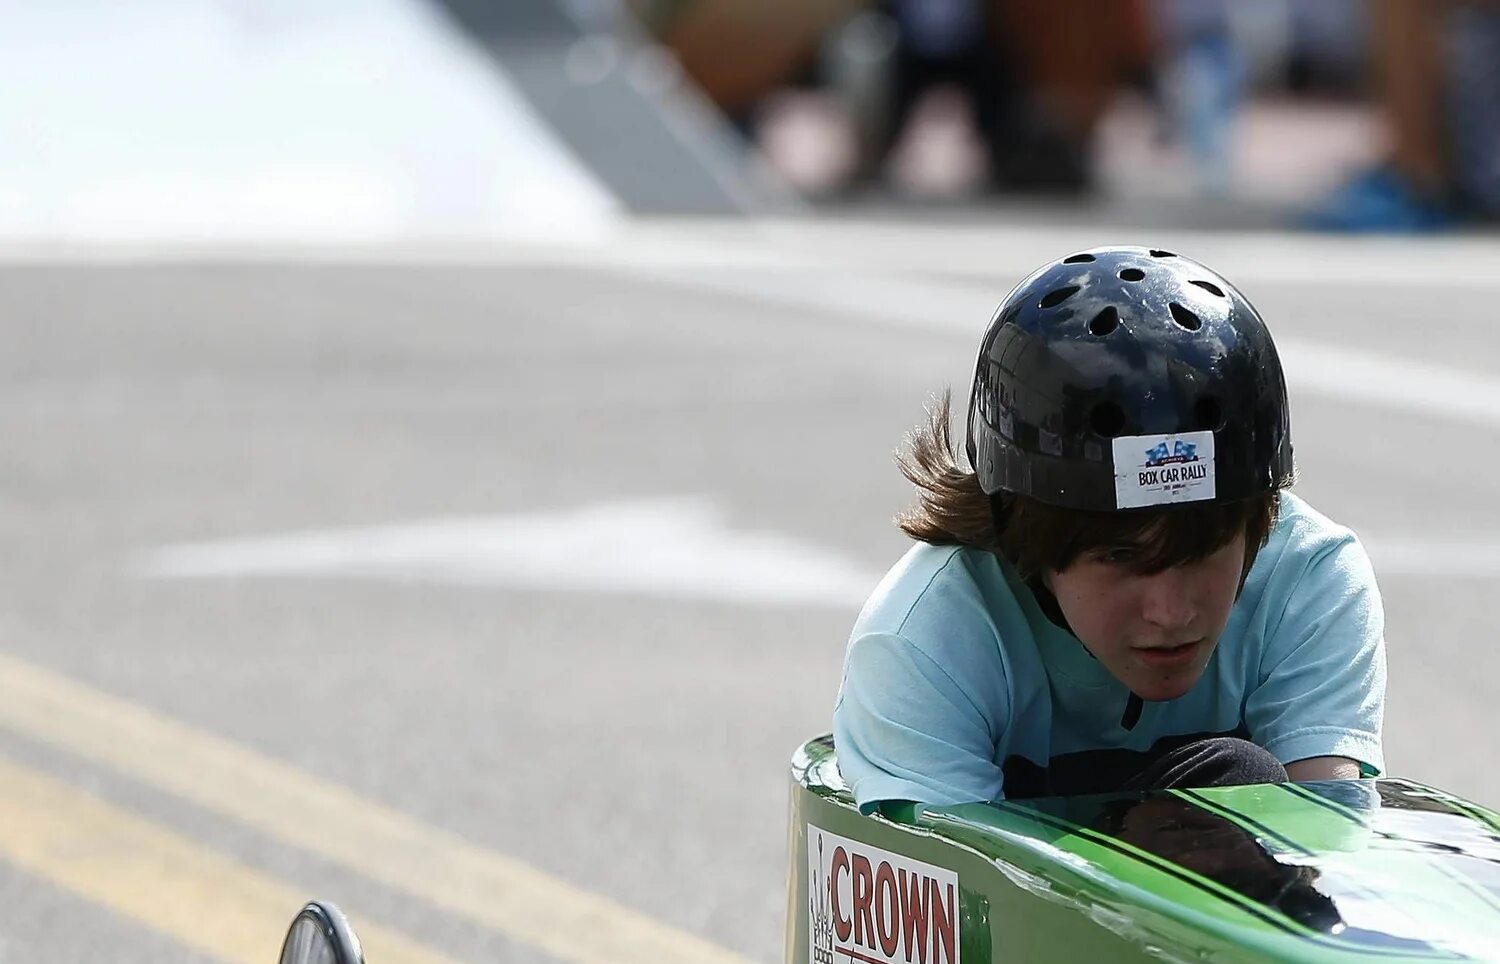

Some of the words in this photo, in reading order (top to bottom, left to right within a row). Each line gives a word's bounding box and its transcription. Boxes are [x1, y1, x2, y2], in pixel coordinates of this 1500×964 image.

[1138, 471, 1158, 486] BOX
[1160, 468, 1179, 483] CAR
[1180, 464, 1207, 480] RALLY
